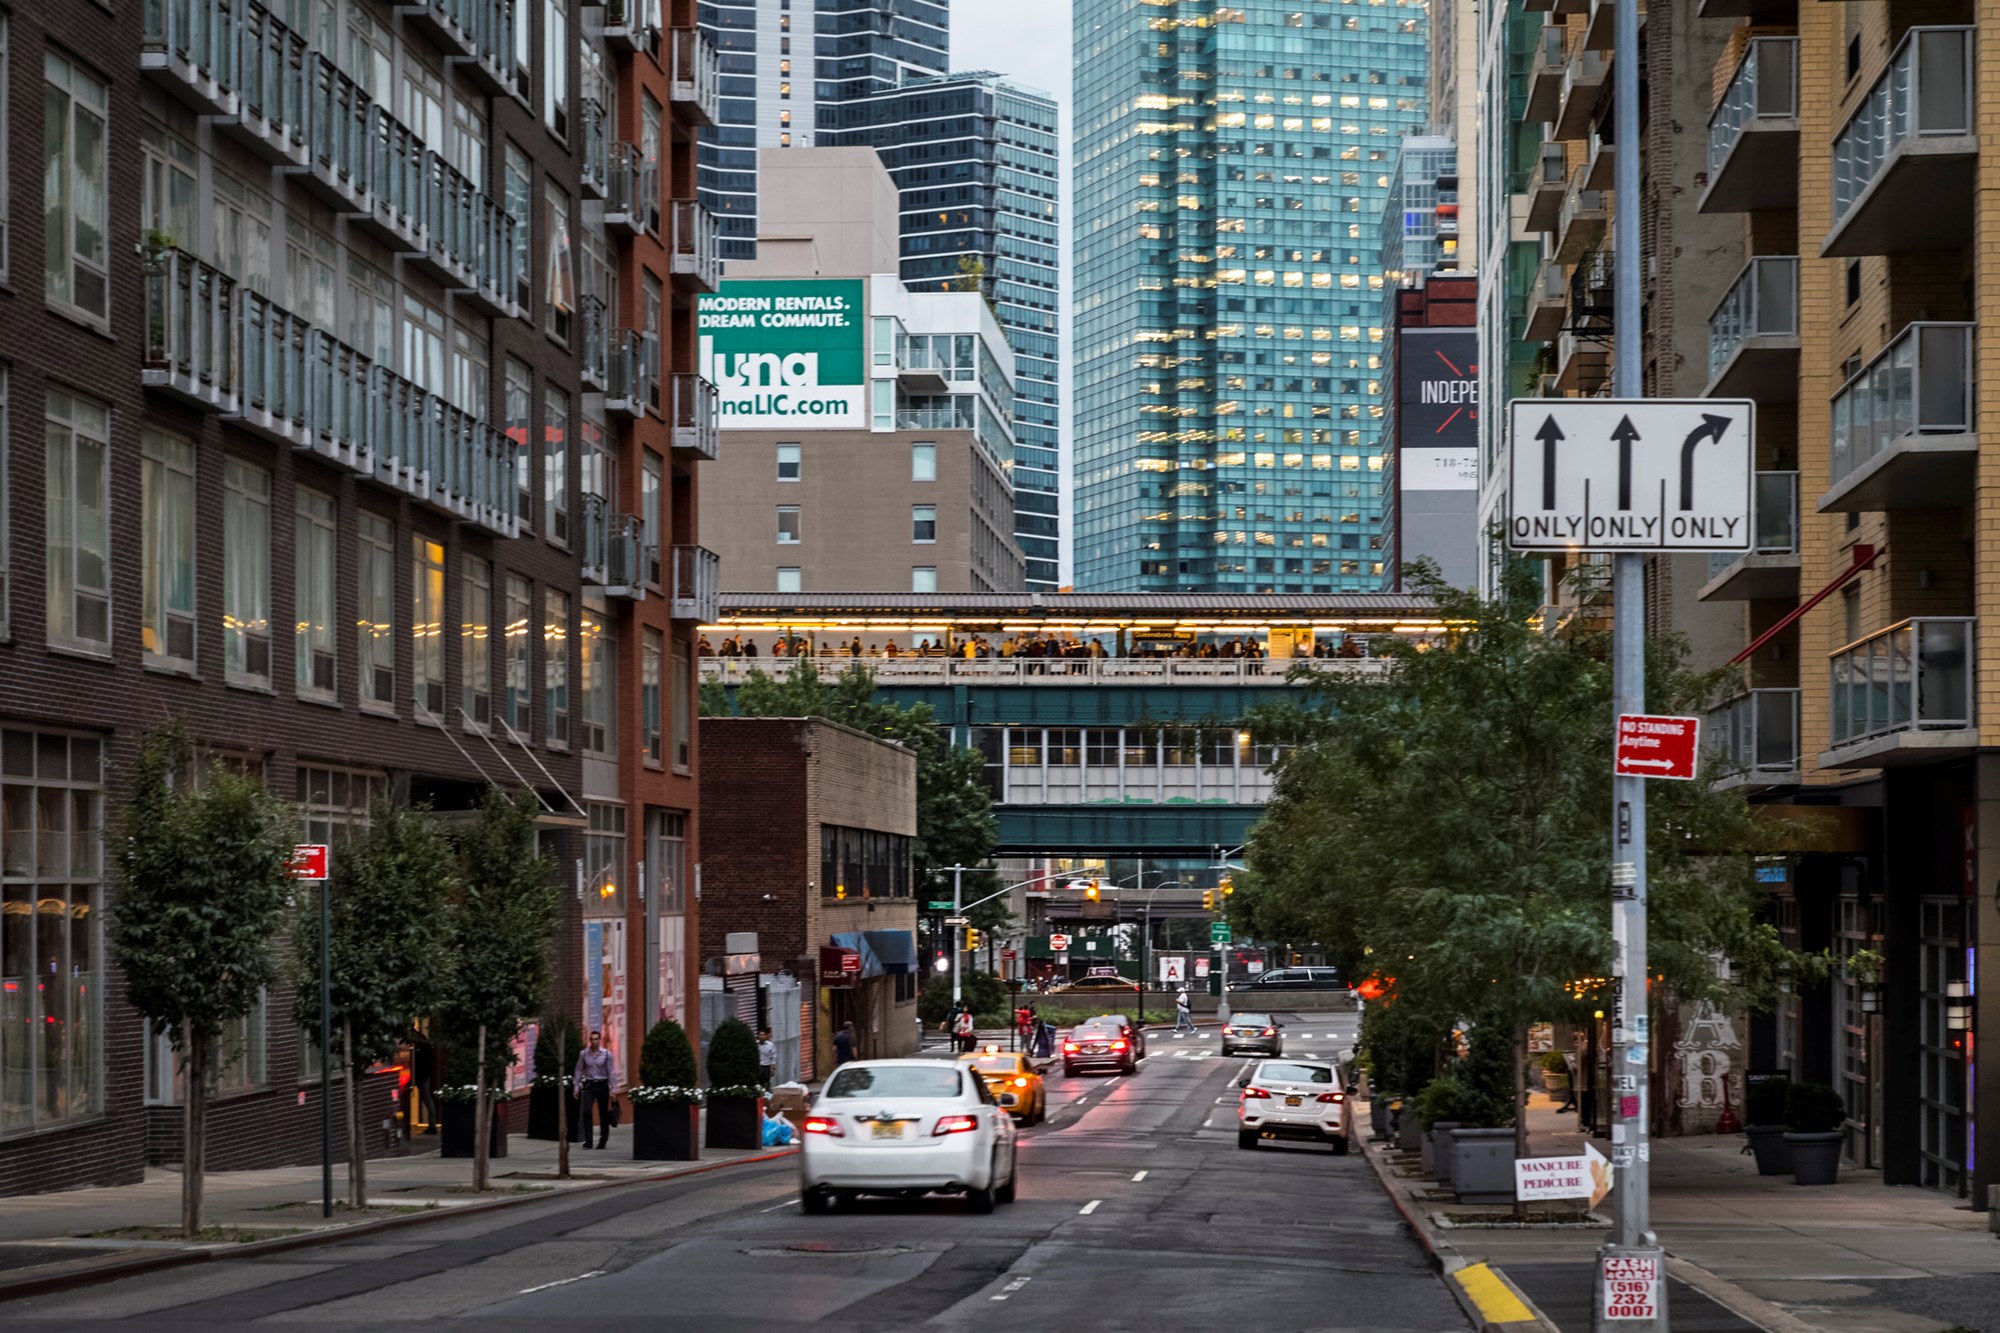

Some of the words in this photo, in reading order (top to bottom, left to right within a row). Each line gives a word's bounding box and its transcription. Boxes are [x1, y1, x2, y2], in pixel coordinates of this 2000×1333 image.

[698, 297, 771, 311] MODERN
[775, 296, 850, 310] RENTALS.
[698, 314, 755, 328] DREAM
[761, 313, 850, 327] COMMUTE.
[718, 394, 848, 415] naLIC.com
[1515, 516, 1582, 538] ONLY
[1591, 516, 1658, 538] ONLY
[1671, 517, 1740, 538] ONLY
[1622, 721, 1636, 732] NO
[1637, 723, 1685, 735] STANDING
[1622, 735, 1661, 748] Anytime
[1166, 966, 1178, 979] A
[1521, 1160, 1583, 1173] MANICURE
[1523, 1177, 1583, 1189] PEDICURE
[1606, 1258, 1652, 1270] CASH
[1611, 1281, 1650, 1292] (516)
[1613, 1293, 1647, 1305] 232
[1608, 1305, 1653, 1317] 0007
